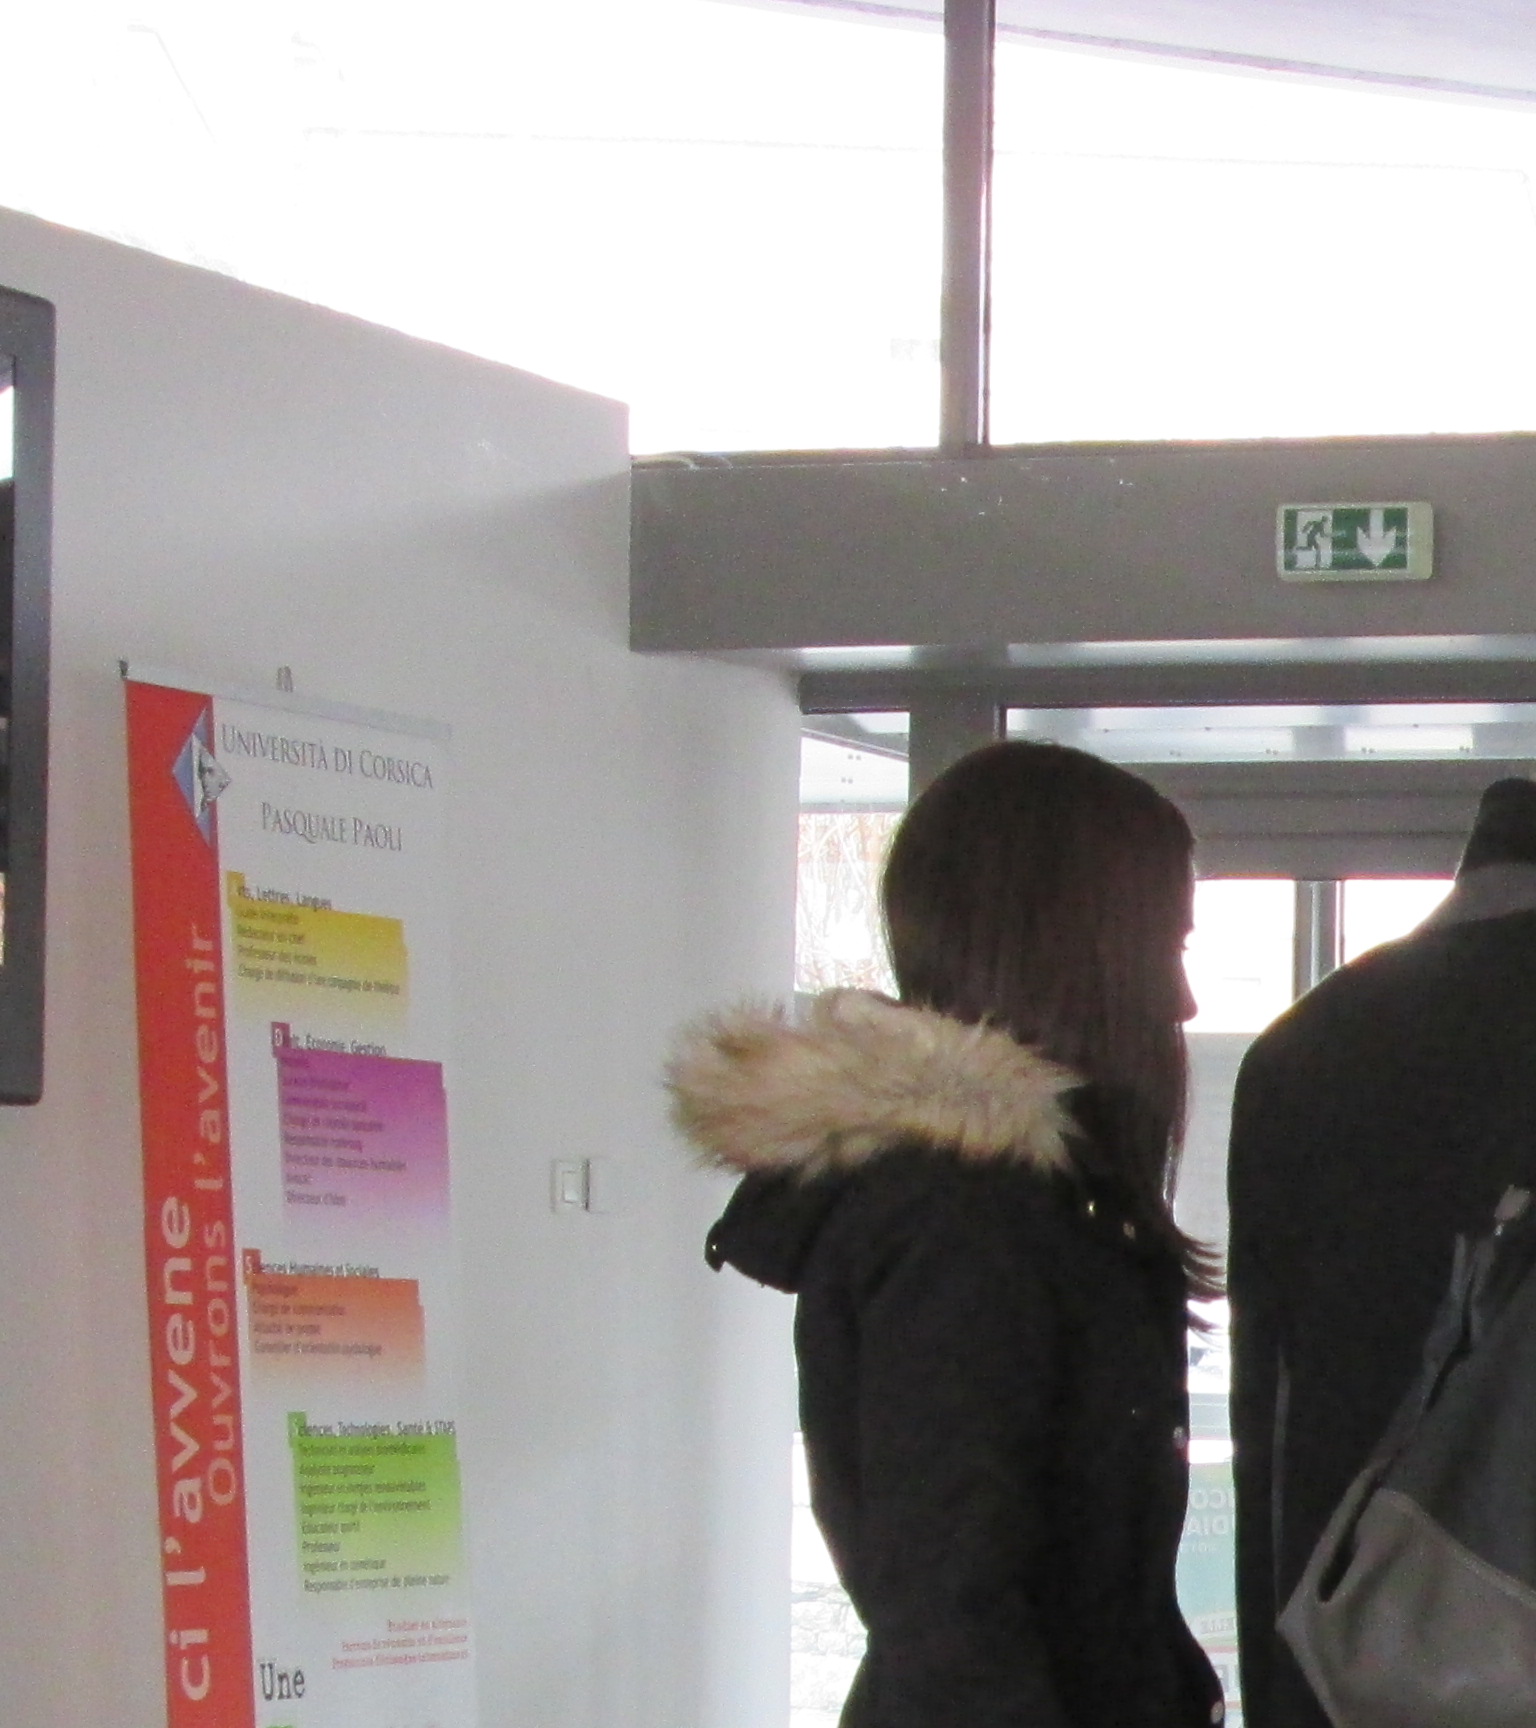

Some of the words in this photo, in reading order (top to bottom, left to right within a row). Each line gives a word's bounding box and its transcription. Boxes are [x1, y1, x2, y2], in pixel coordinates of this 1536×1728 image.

[185, 921, 224, 1191] l'avenir
[161, 1195, 207, 1588] l'avvene
[204, 1219, 236, 1507] Ouvrons
[170, 1628, 211, 1701] ci
[260, 1662, 306, 1702] Une
